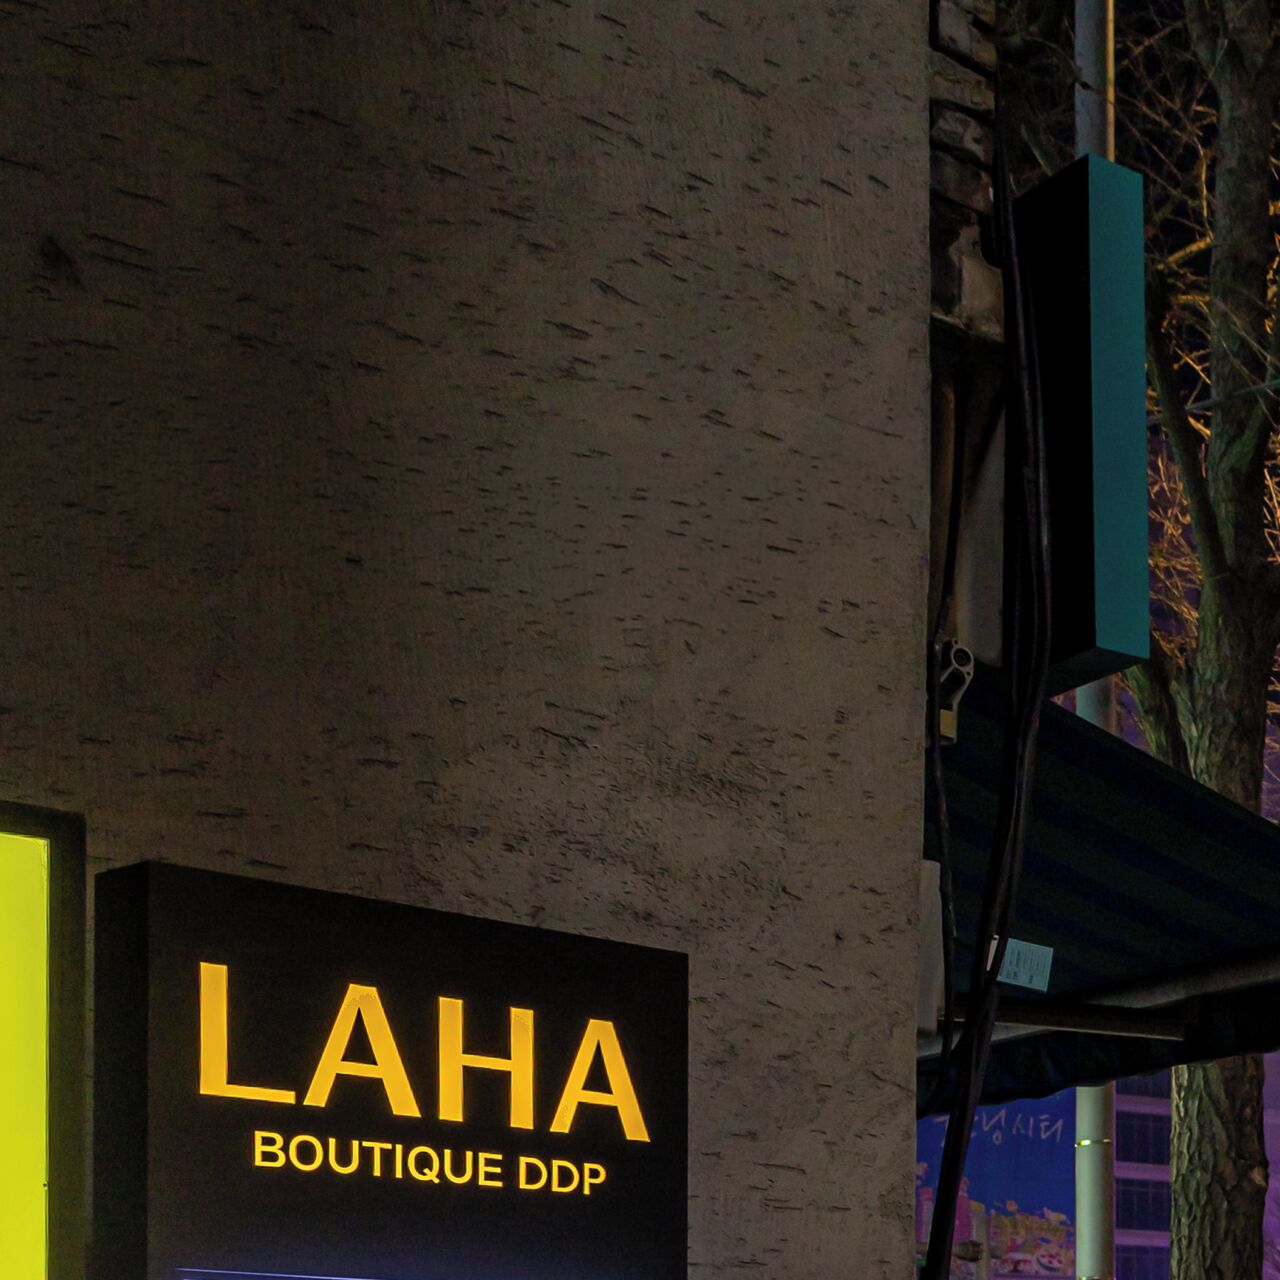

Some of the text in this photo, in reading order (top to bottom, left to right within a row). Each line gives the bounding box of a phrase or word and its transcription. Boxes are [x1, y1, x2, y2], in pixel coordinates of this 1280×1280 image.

[199, 961, 651, 1143] LAHA
[932, 1108, 1064, 1147] 닝시티
[254, 1130, 607, 1196] BOUTIQUE DDP
